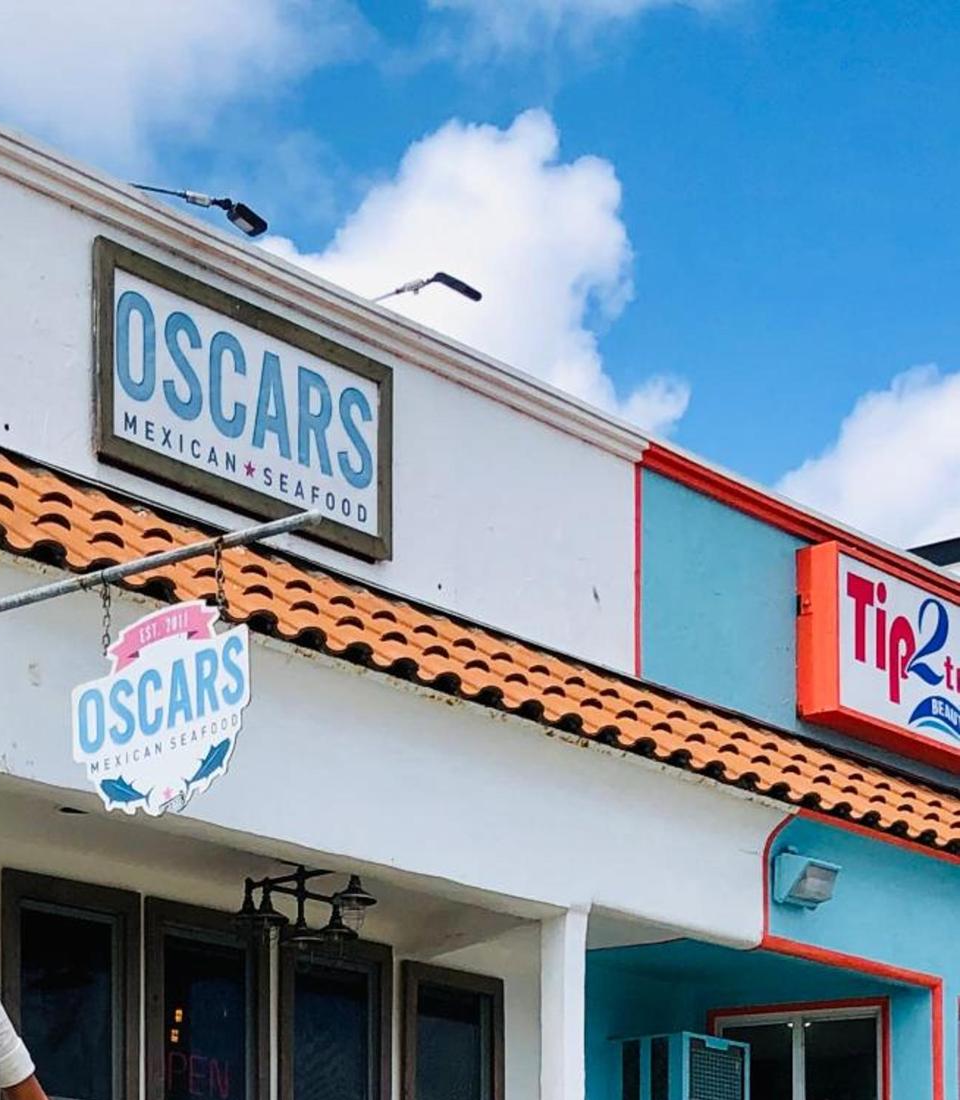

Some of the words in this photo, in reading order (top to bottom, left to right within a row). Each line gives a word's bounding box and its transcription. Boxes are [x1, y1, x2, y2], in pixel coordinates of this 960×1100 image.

[116, 290, 373, 490] OSCARS
[124, 411, 237, 472] MEXICAN
[263, 468, 368, 524] SEAFOOD
[78, 635, 245, 754] OSCARS
[847, 571, 916, 705] Tip
[907, 598, 949, 686] 2
[90, 742, 163, 774] MEXICAN
[170, 713, 239, 750] SEAFOOD
